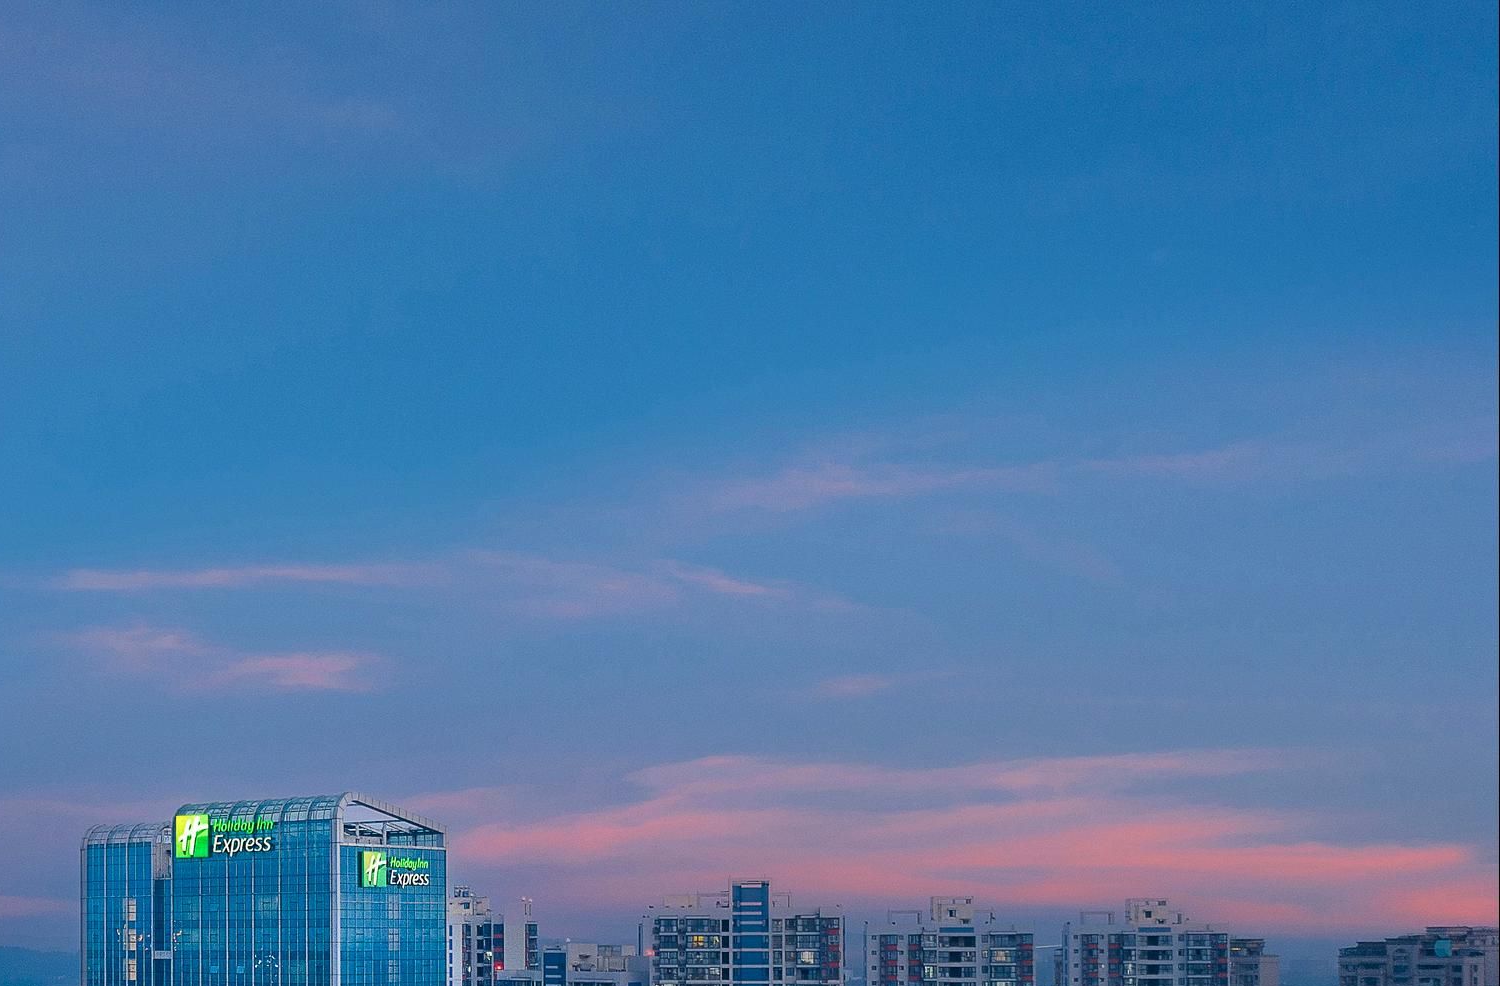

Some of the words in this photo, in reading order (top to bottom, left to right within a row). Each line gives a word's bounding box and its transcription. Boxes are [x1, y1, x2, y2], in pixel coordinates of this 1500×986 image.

[213, 816, 255, 833] Holiday
[256, 815, 274, 831] Inn
[212, 834, 272, 857] Express
[390, 856, 417, 870] Holiday
[417, 857, 429, 869] Inn
[390, 869, 430, 888] Express
